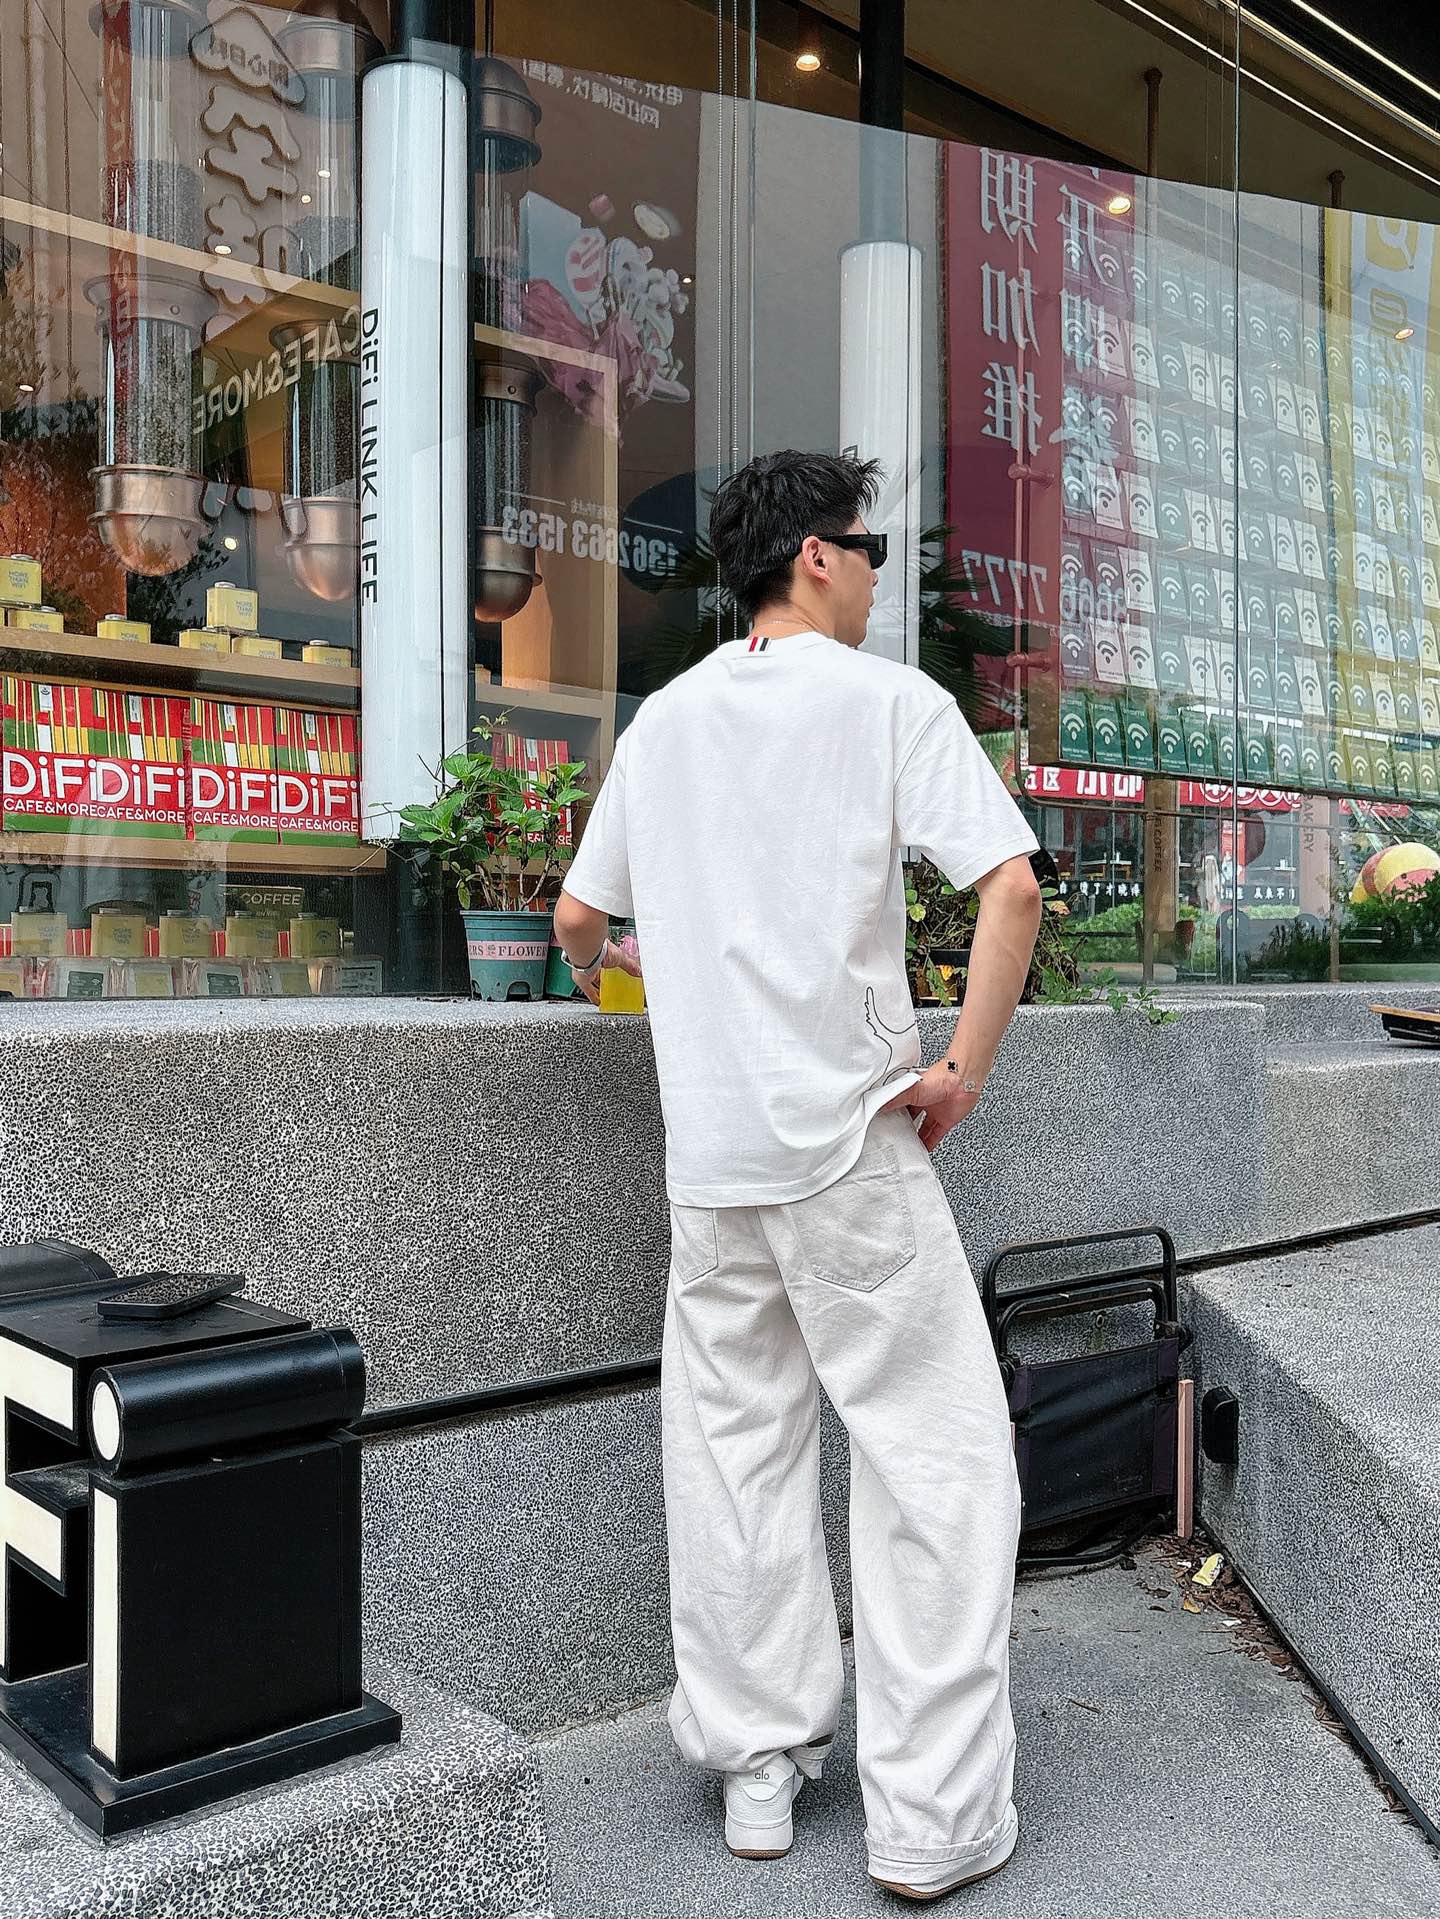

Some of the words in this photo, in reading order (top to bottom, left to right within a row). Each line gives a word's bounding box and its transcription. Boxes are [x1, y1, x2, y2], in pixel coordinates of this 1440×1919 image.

[361, 308, 379, 387] DiFi
[361, 397, 378, 499] LINK
[361, 512, 379, 606] LIFE
[3, 751, 97, 800] DiFi
[97, 759, 186, 808] DiFi
[192, 768, 278, 813] DiFi
[278, 774, 358, 818] DiFi
[3, 798, 97, 816] CAFE&MORE
[97, 806, 186, 823] CAFE&MORE
[193, 811, 278, 828] CAFE&MORE
[279, 818, 359, 832] CAFE&MORE
[240, 893, 301, 905] COFFEE
[754, 1769, 770, 1780] alo
